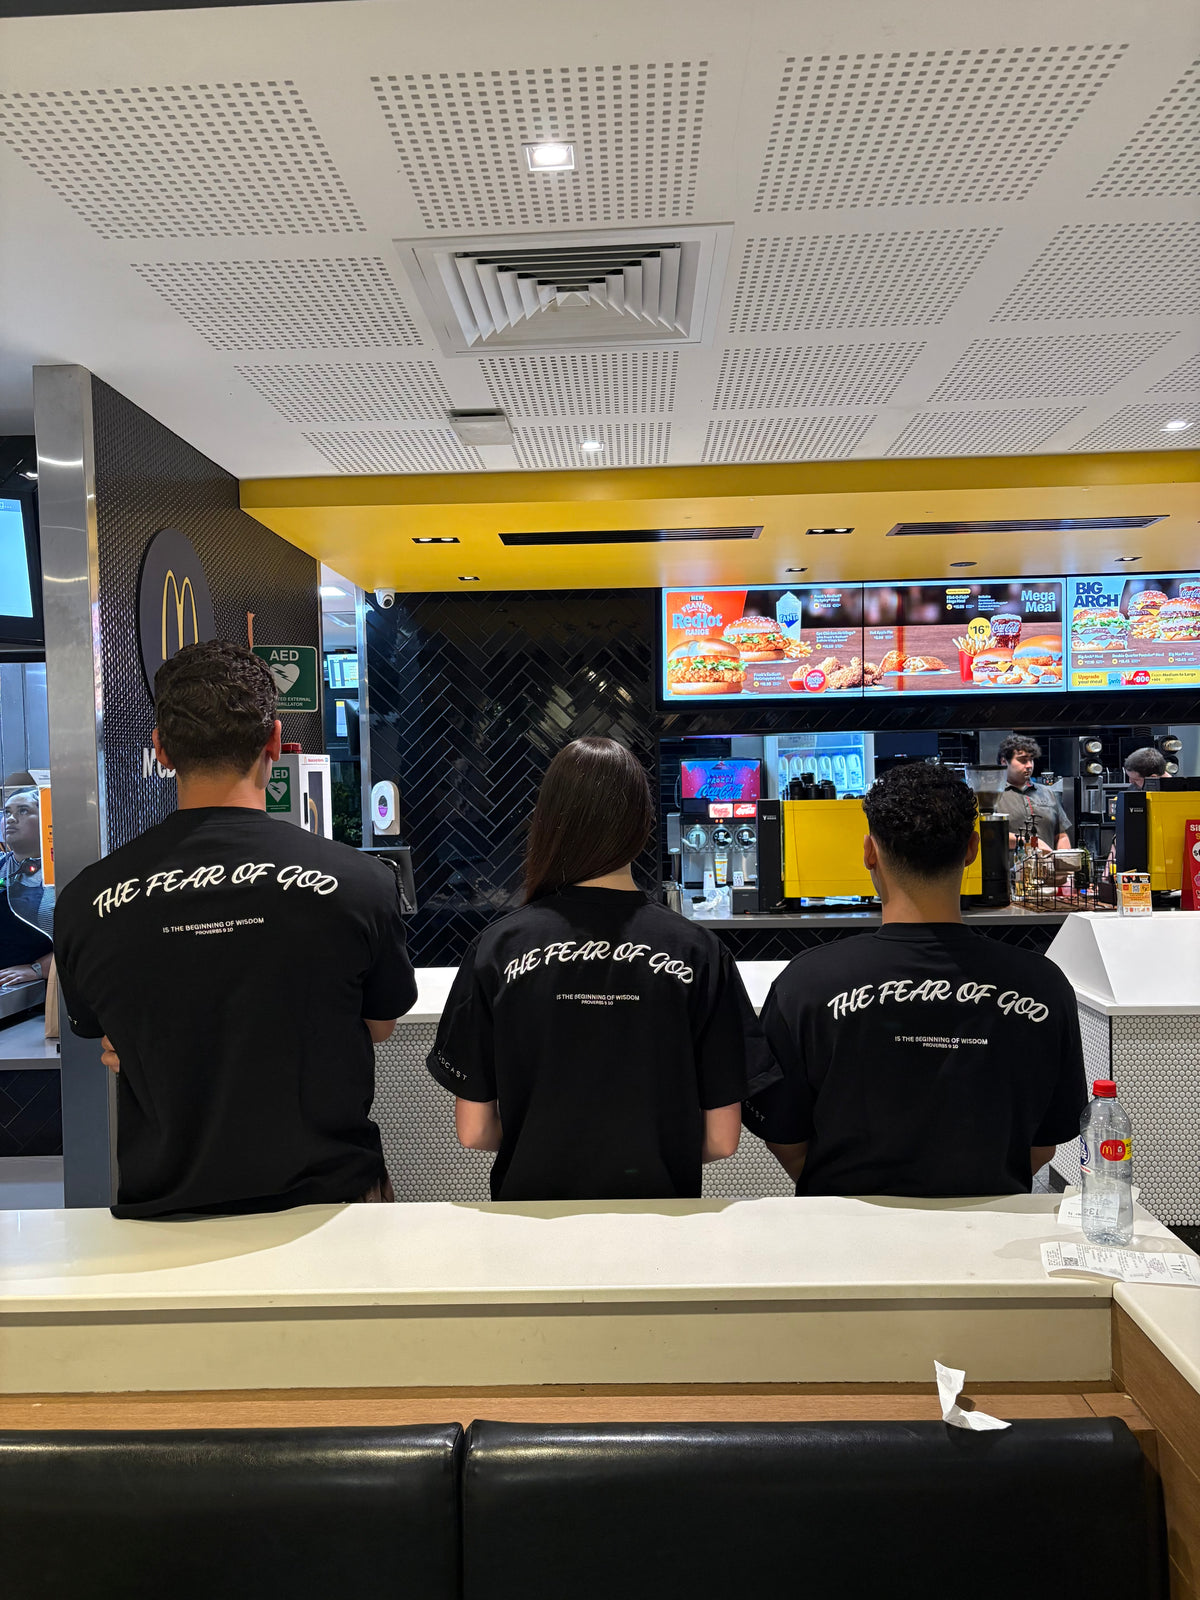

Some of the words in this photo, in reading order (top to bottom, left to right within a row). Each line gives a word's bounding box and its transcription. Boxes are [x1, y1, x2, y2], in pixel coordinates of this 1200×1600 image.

[1075, 582, 1103, 595] BIG
[1021, 589, 1056, 606] Mega
[1074, 594, 1119, 608] ARCH
[1025, 601, 1056, 613] Meal
[672, 613, 723, 629] RedHot
[270, 650, 299, 661] AED
[93, 878, 140, 918] THE
[146, 864, 226, 897] FEAR
[231, 862, 275, 885] OF
[276, 865, 339, 896] GOD
[171, 925, 184, 933] THE
[185, 921, 225, 931] BEGINNING
[235, 917, 265, 926] WISDOM
[503, 948, 542, 984] THE
[544, 940, 611, 966] FEAR
[612, 942, 652, 963] OF
[649, 952, 694, 985] GOD
[827, 984, 875, 1020] THE
[878, 979, 952, 1005] FEAR
[955, 981, 998, 1005] OF
[997, 990, 1050, 1023] GOD
